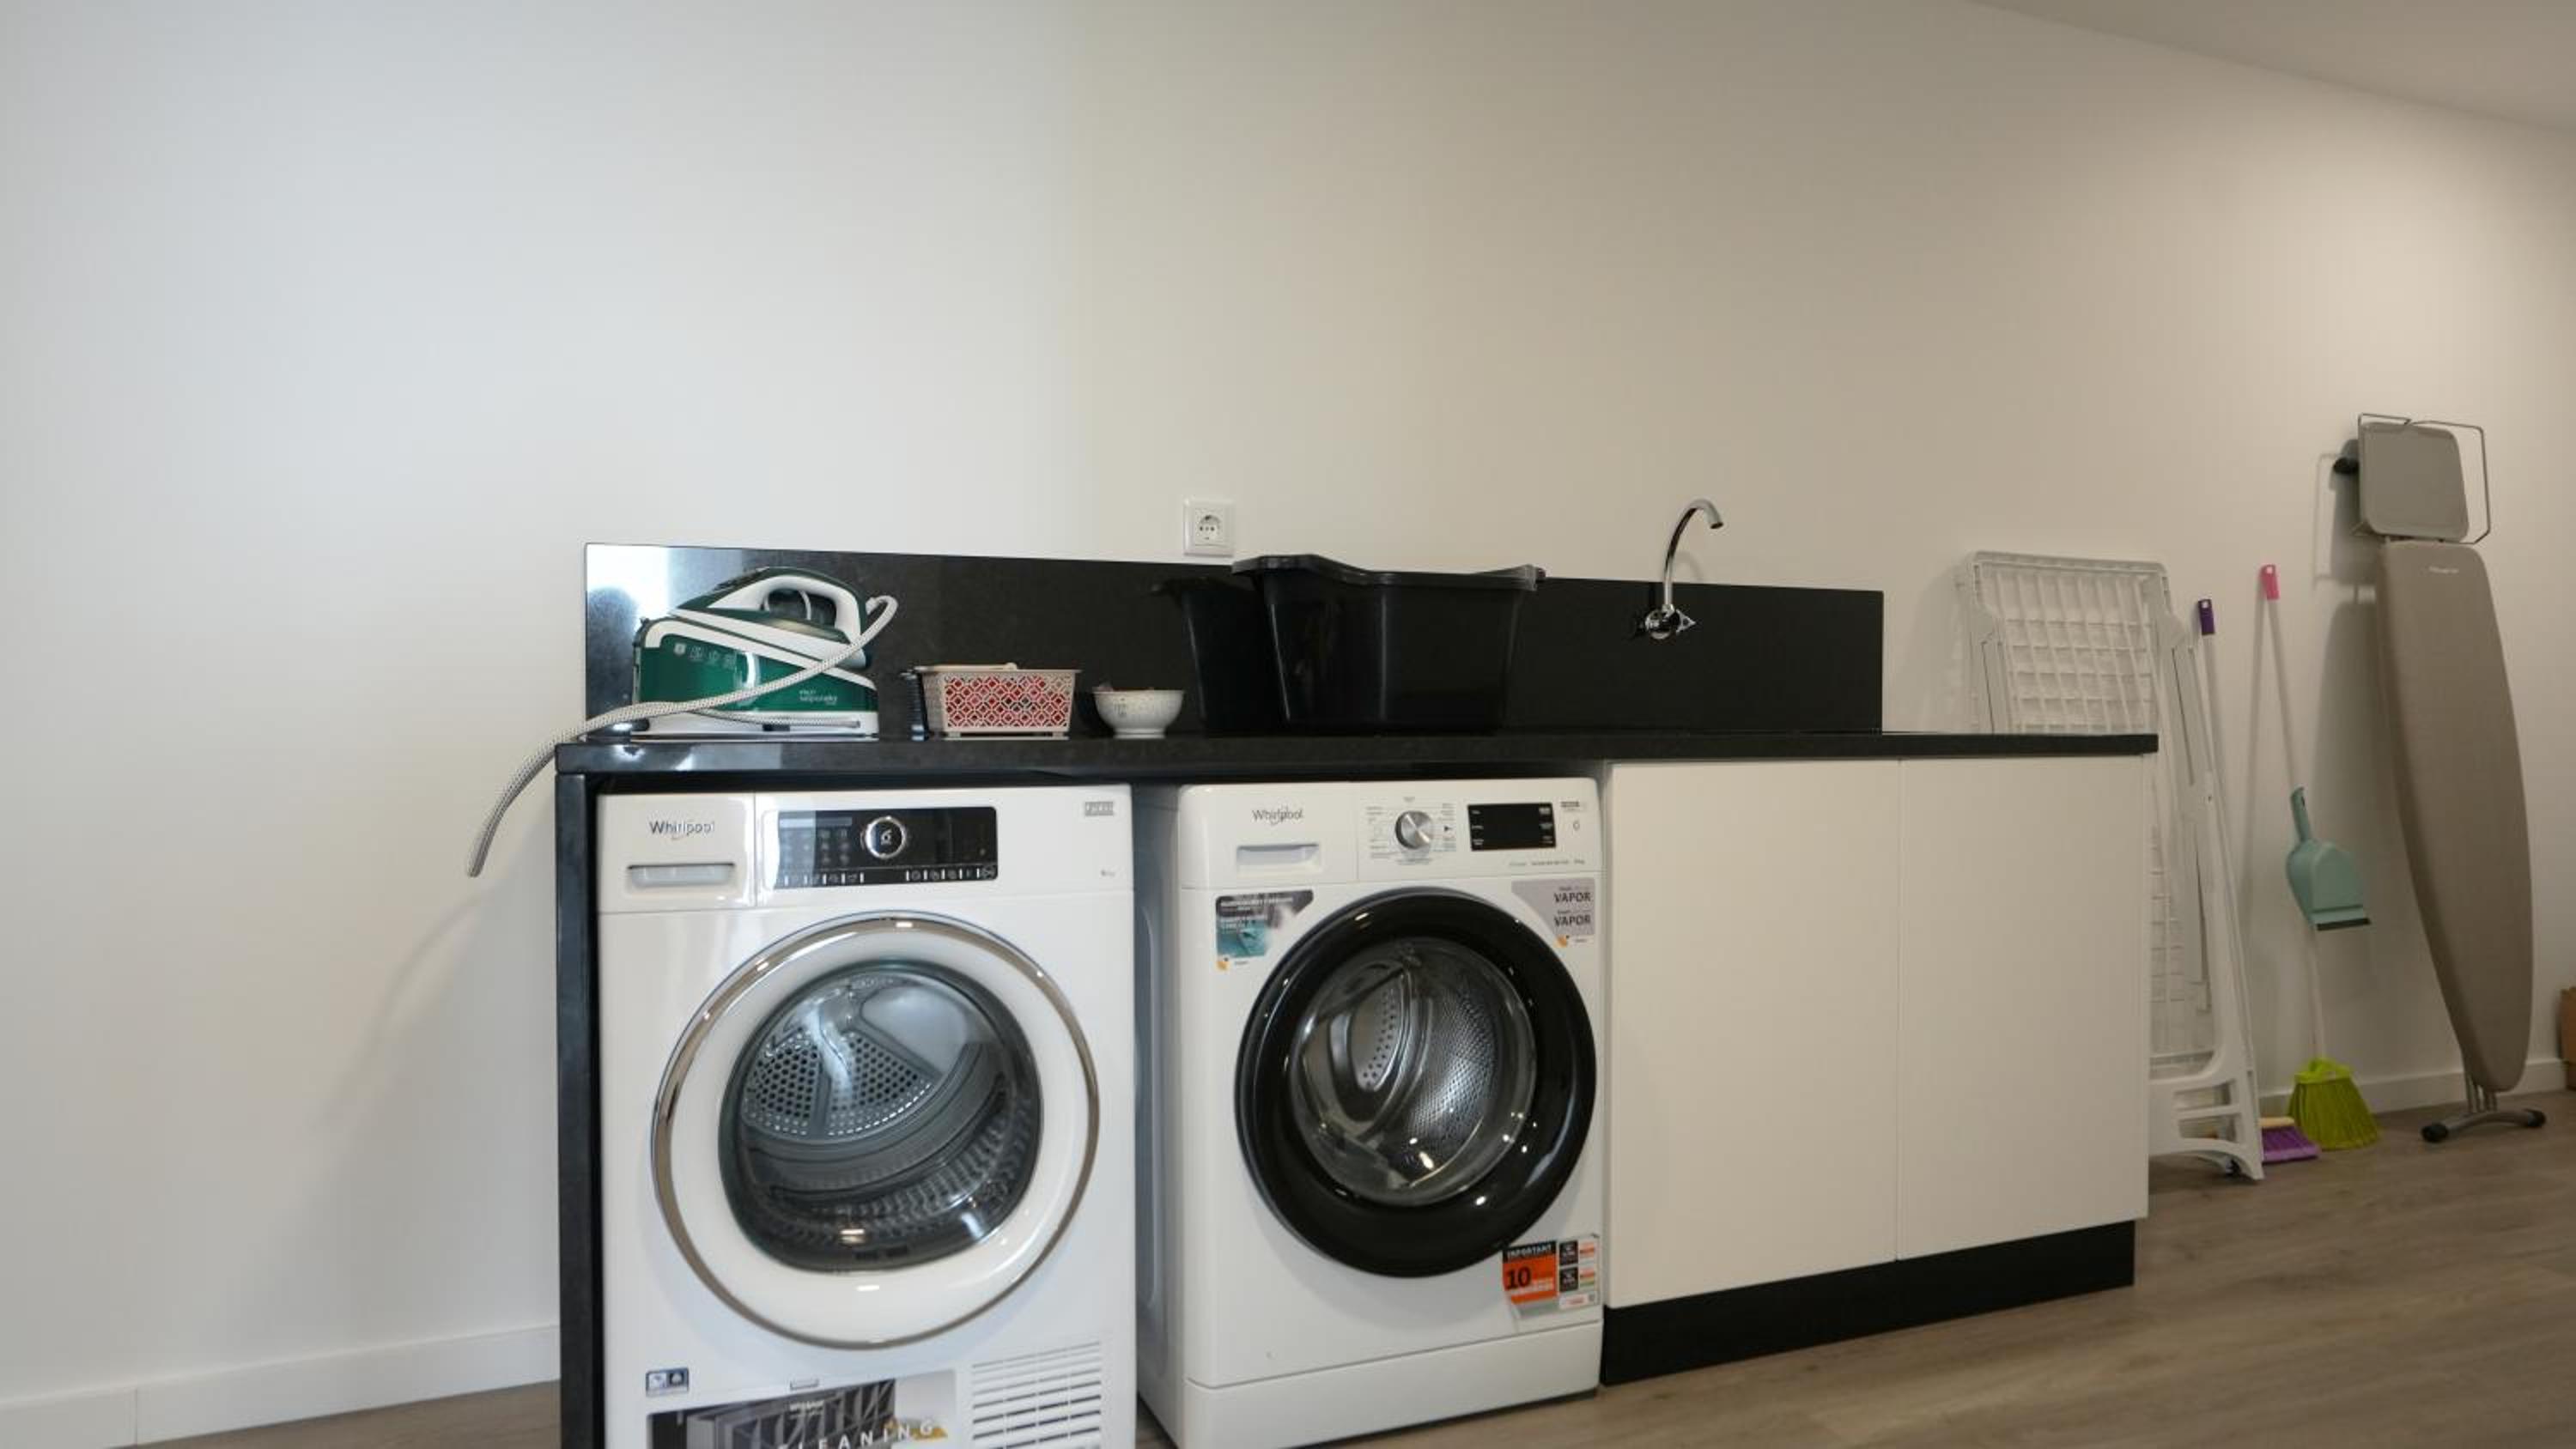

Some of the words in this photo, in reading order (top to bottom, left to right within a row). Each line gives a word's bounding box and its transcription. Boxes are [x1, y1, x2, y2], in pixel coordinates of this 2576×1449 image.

[1251, 806, 1303, 825] Whirlpool
[649, 820, 714, 838] Whirlpool
[1553, 892, 1591, 903] VAPOR
[1553, 915, 1591, 926] VAPOR
[1507, 1243, 1552, 1258] IMPORTANT
[1506, 1266, 1531, 1291] 10
